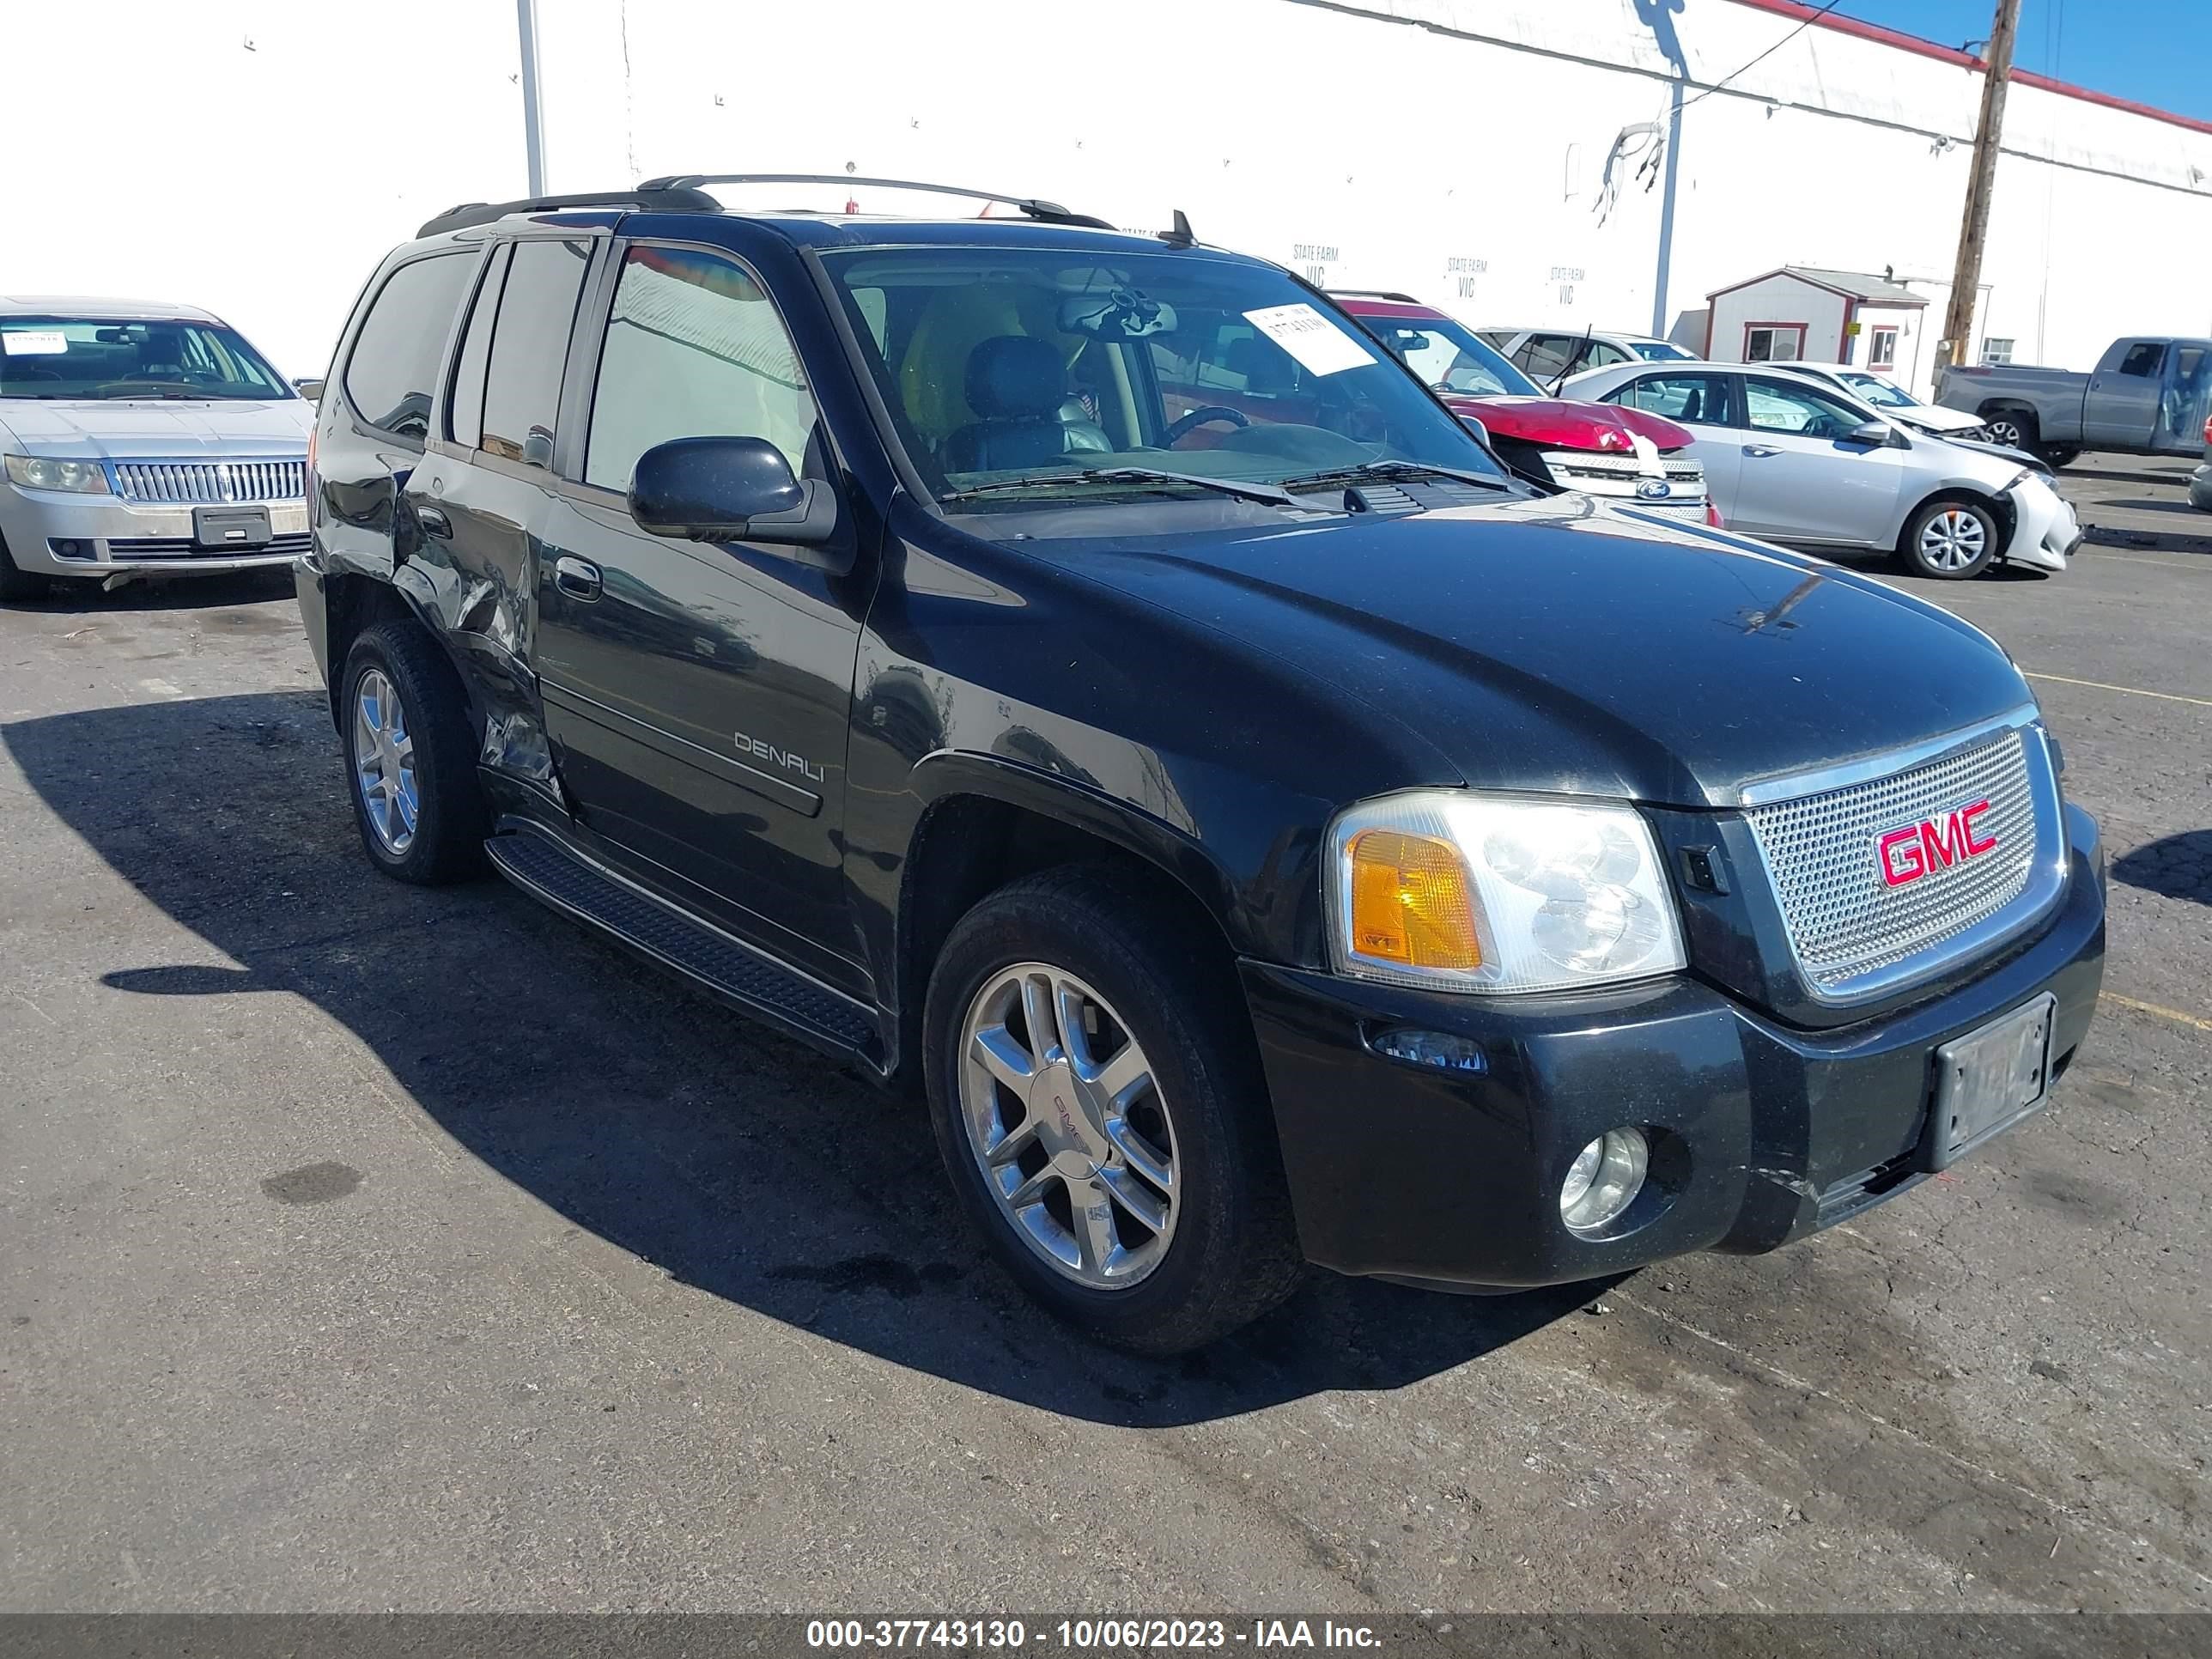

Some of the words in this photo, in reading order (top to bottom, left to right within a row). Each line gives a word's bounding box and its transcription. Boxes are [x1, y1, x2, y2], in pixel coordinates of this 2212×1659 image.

[1293, 244, 1315, 260] STATE
[1316, 246, 1339, 261] FARM
[1448, 258, 1467, 272] STATE
[1468, 258, 1487, 273] FARM
[1551, 267, 1567, 281] STATE
[1569, 268, 1585, 282] FARM
[1306, 265, 1324, 289] VIC
[1459, 276, 1475, 298] VIC
[1559, 285, 1574, 305] VIC
[734, 731, 824, 783] DENALI
[1879, 799, 1997, 887] GMC
[1054, 1095, 1086, 1150] GMC
